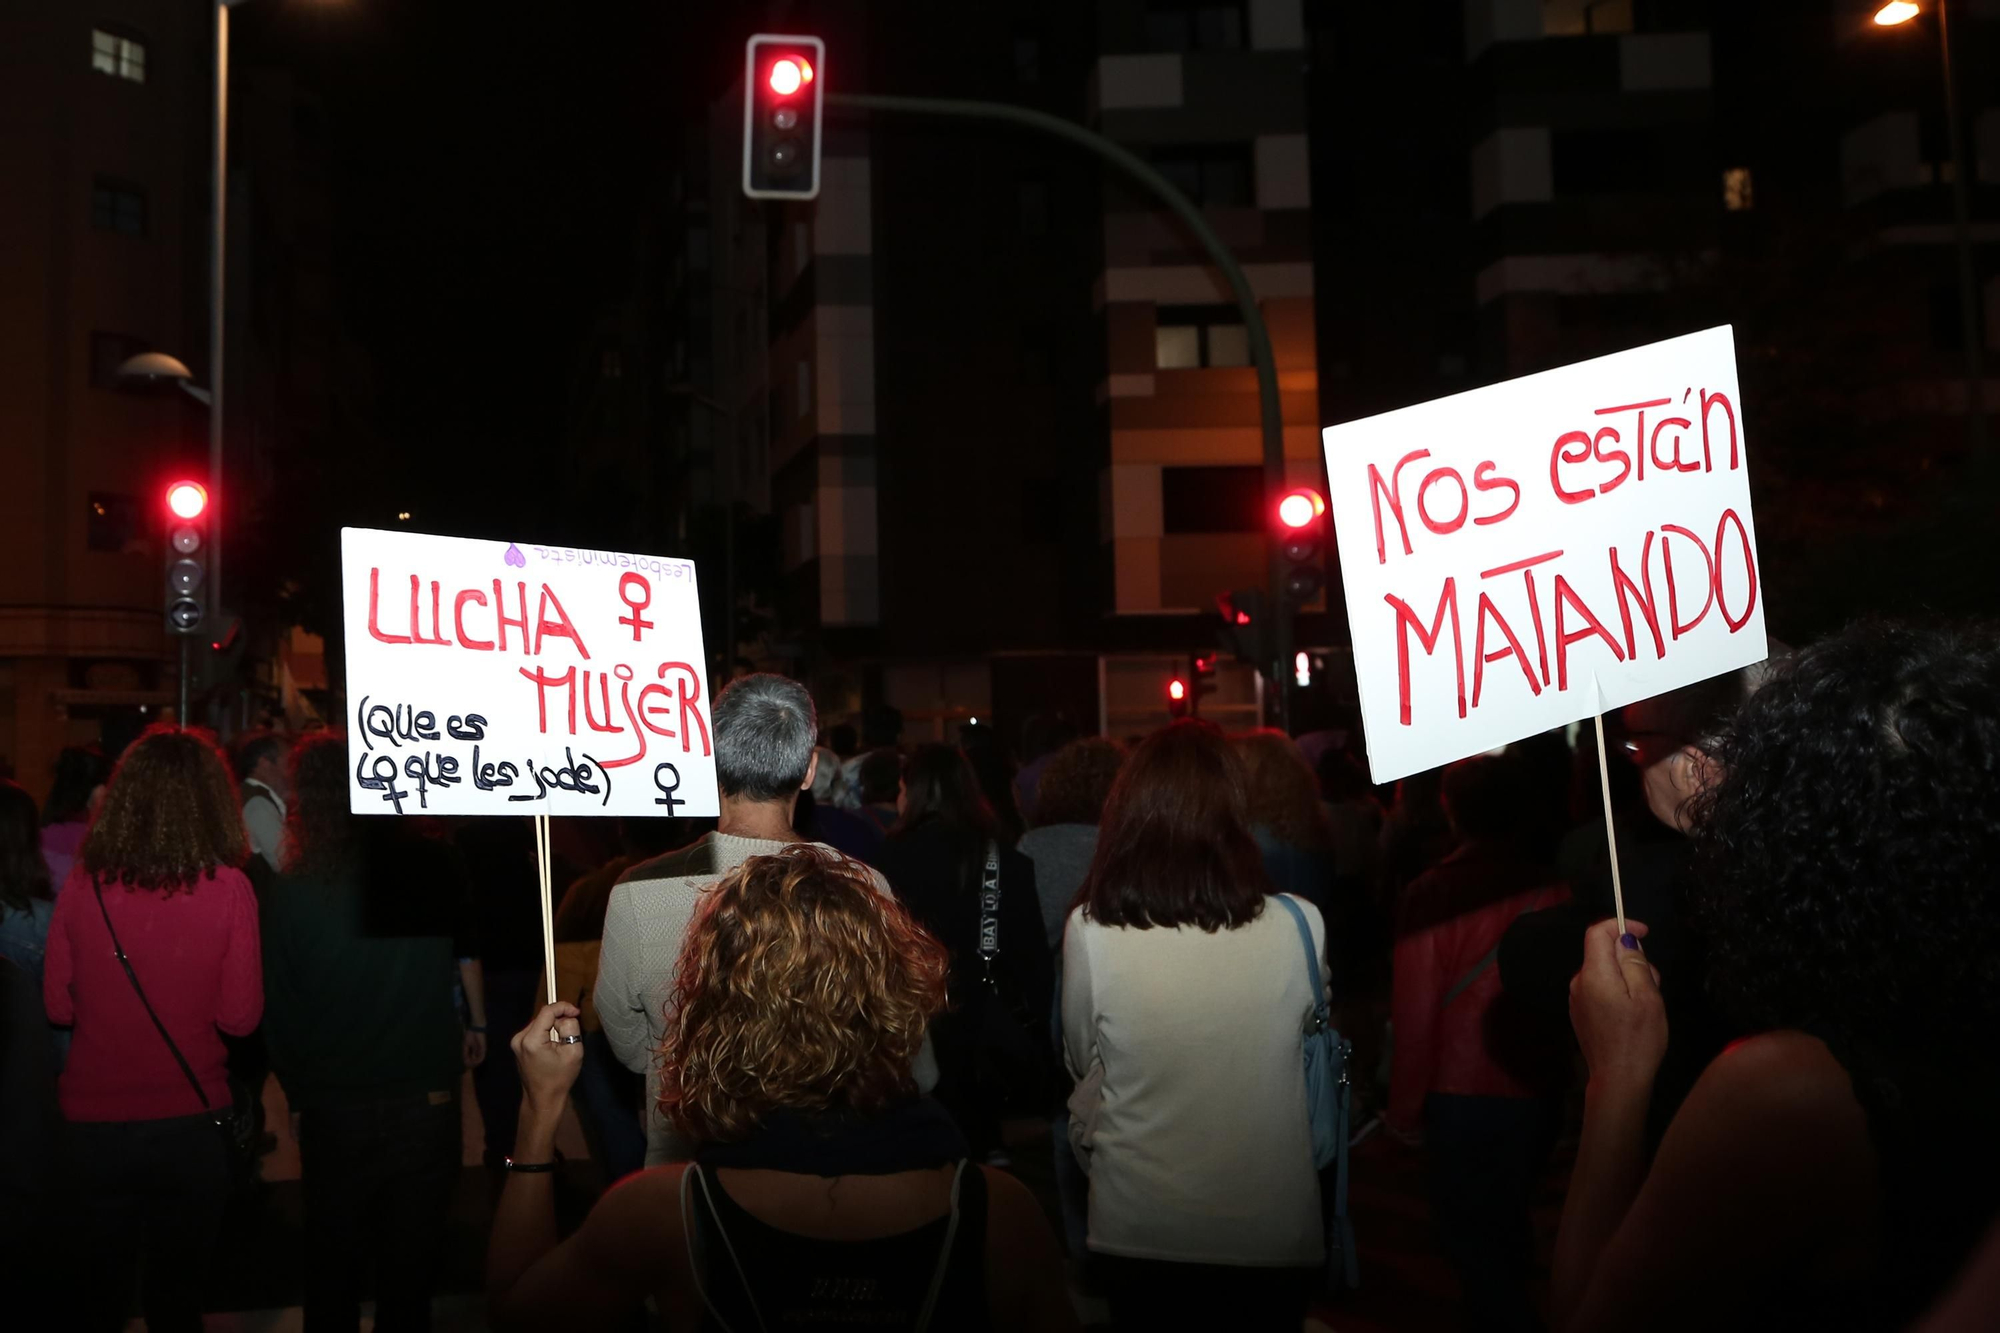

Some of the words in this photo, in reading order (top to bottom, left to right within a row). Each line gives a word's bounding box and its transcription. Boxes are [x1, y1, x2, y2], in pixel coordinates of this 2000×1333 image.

[1368, 448, 1520, 564] Nos
[368, 567, 591, 660] LUCHA
[1384, 508, 1757, 726] MATANDO
[446, 713, 488, 741] es
[404, 751, 462, 809] que
